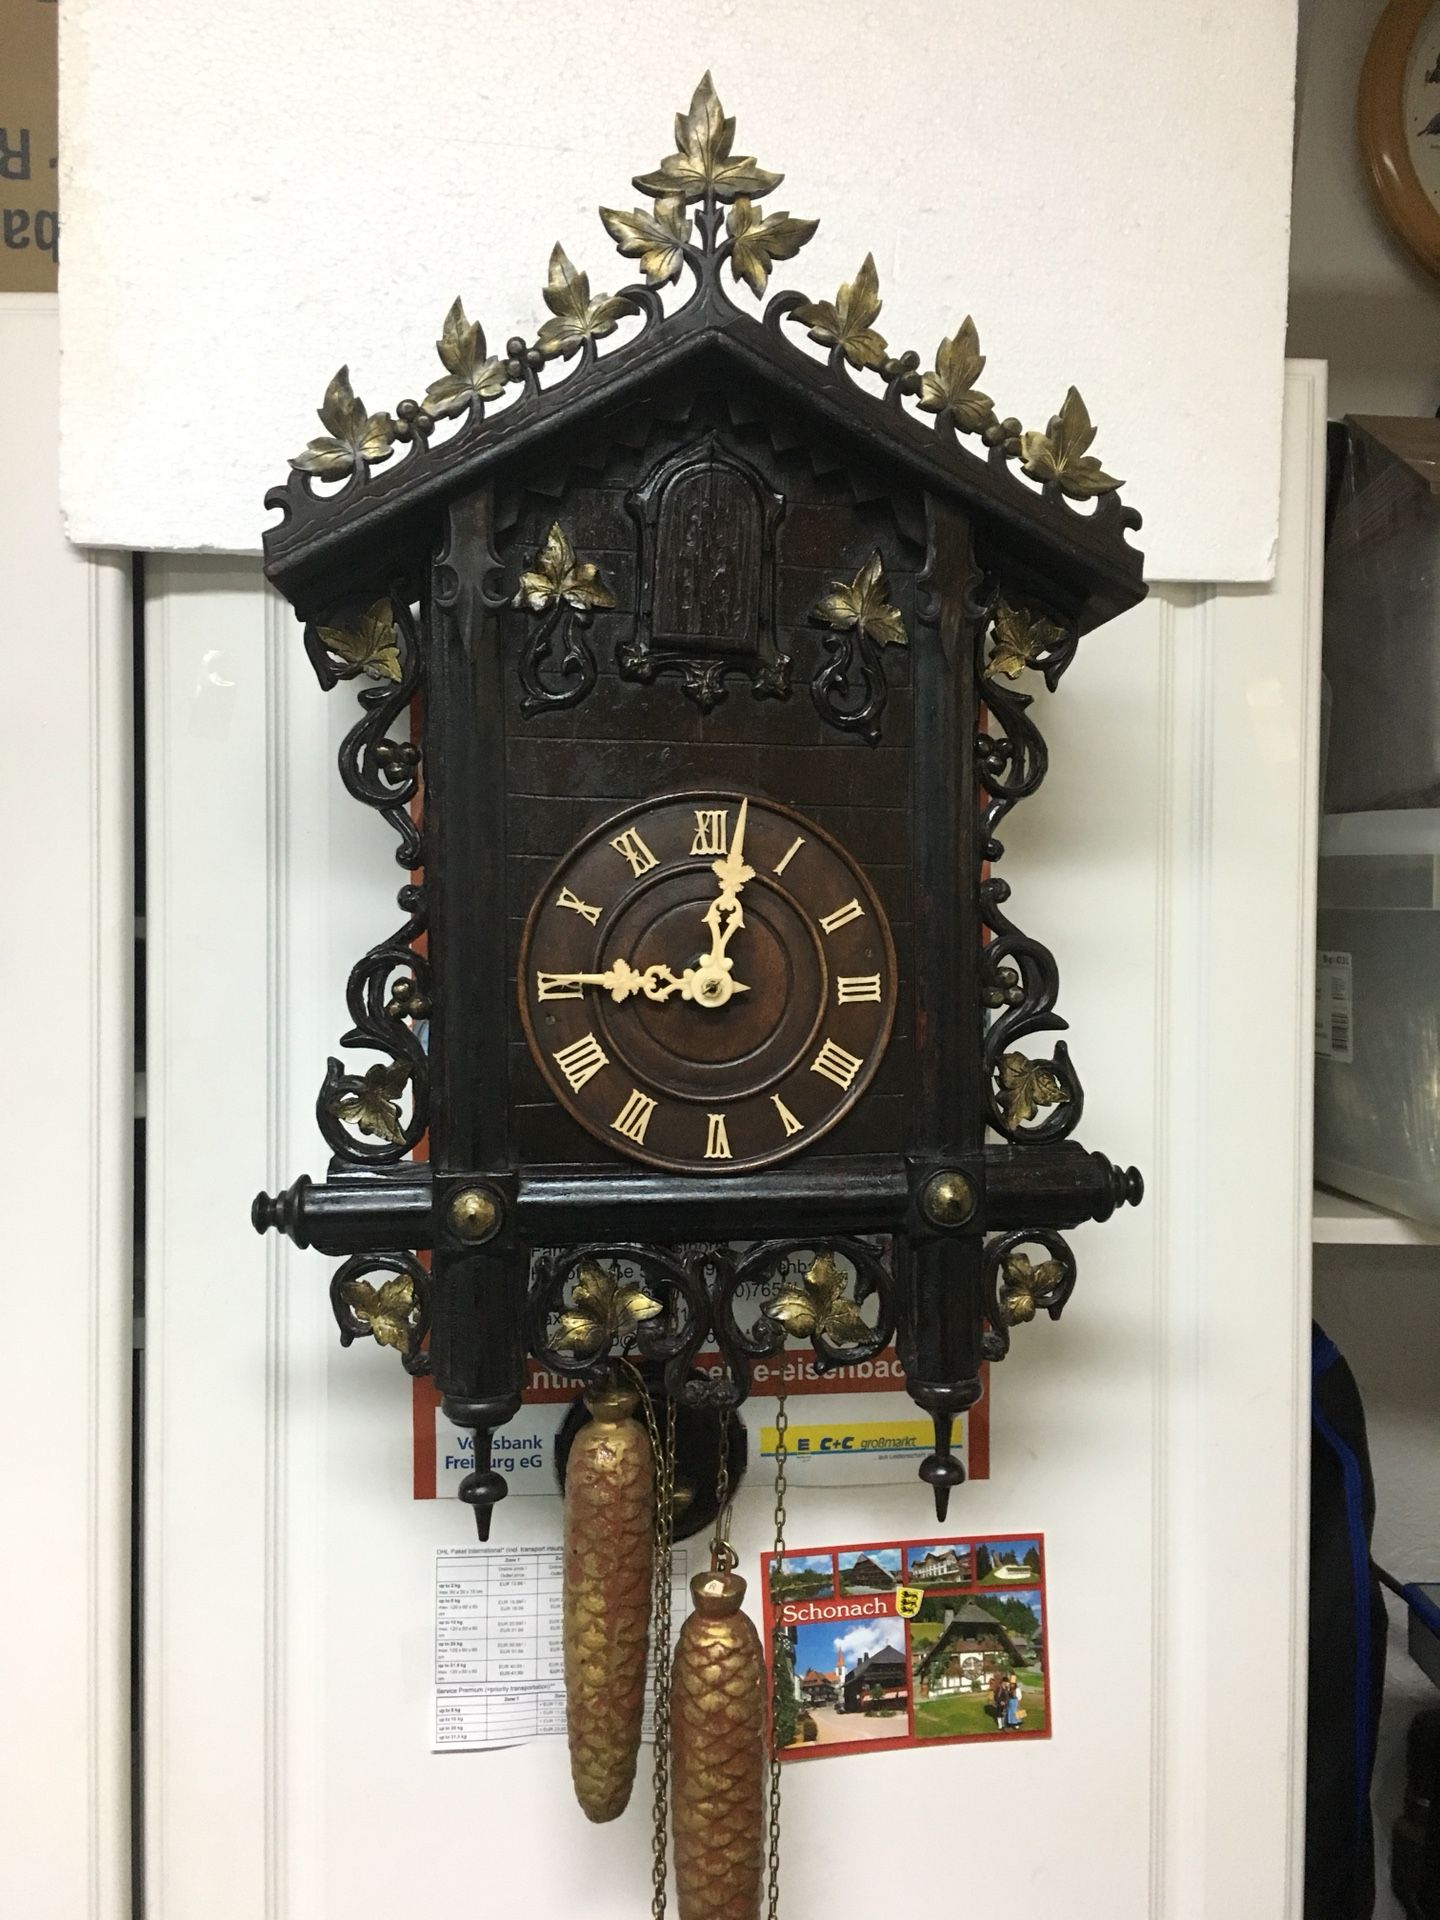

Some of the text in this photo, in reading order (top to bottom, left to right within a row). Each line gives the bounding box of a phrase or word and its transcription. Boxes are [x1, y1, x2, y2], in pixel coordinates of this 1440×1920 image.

[689, 810, 728, 856] XII
[609, 827, 661, 879] XI
[556, 887, 603, 927] X
[819, 898, 865, 934] II
[837, 973, 882, 1006] III
[770, 1093, 804, 1138] V
[445, 1454, 542, 1472] Freiurg eG
[782, 1598, 888, 1622] Schonach
